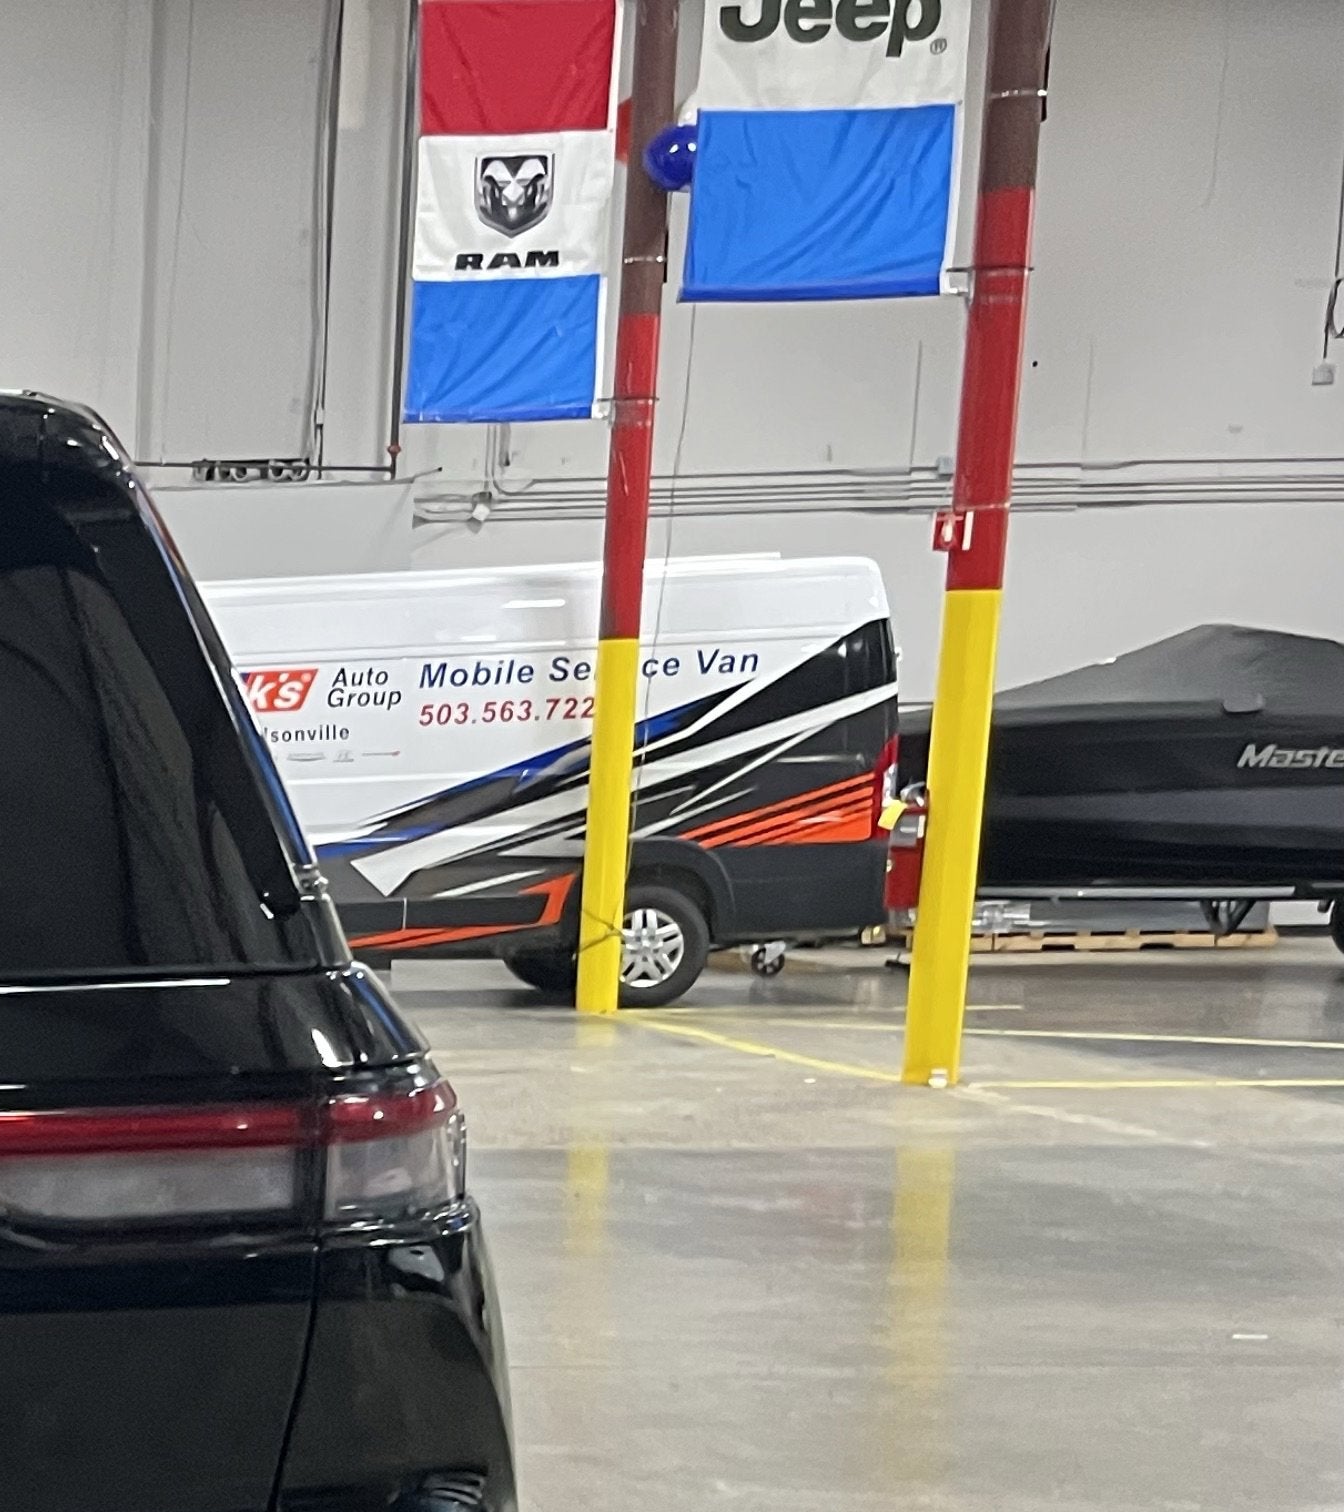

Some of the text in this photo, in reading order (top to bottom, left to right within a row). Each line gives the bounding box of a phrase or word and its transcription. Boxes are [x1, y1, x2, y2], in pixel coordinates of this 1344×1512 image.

[720, 0, 941, 58] Jeep
[455, 250, 559, 271] RAM
[332, 667, 389, 688] Auto
[419, 649, 759, 689] Mobile Sece Van
[248, 673, 304, 710] k's
[327, 688, 402, 711] Group
[419, 697, 595, 727] 503.563.722
[264, 724, 350, 743] lsonville
[1237, 744, 1344, 768] Maste
